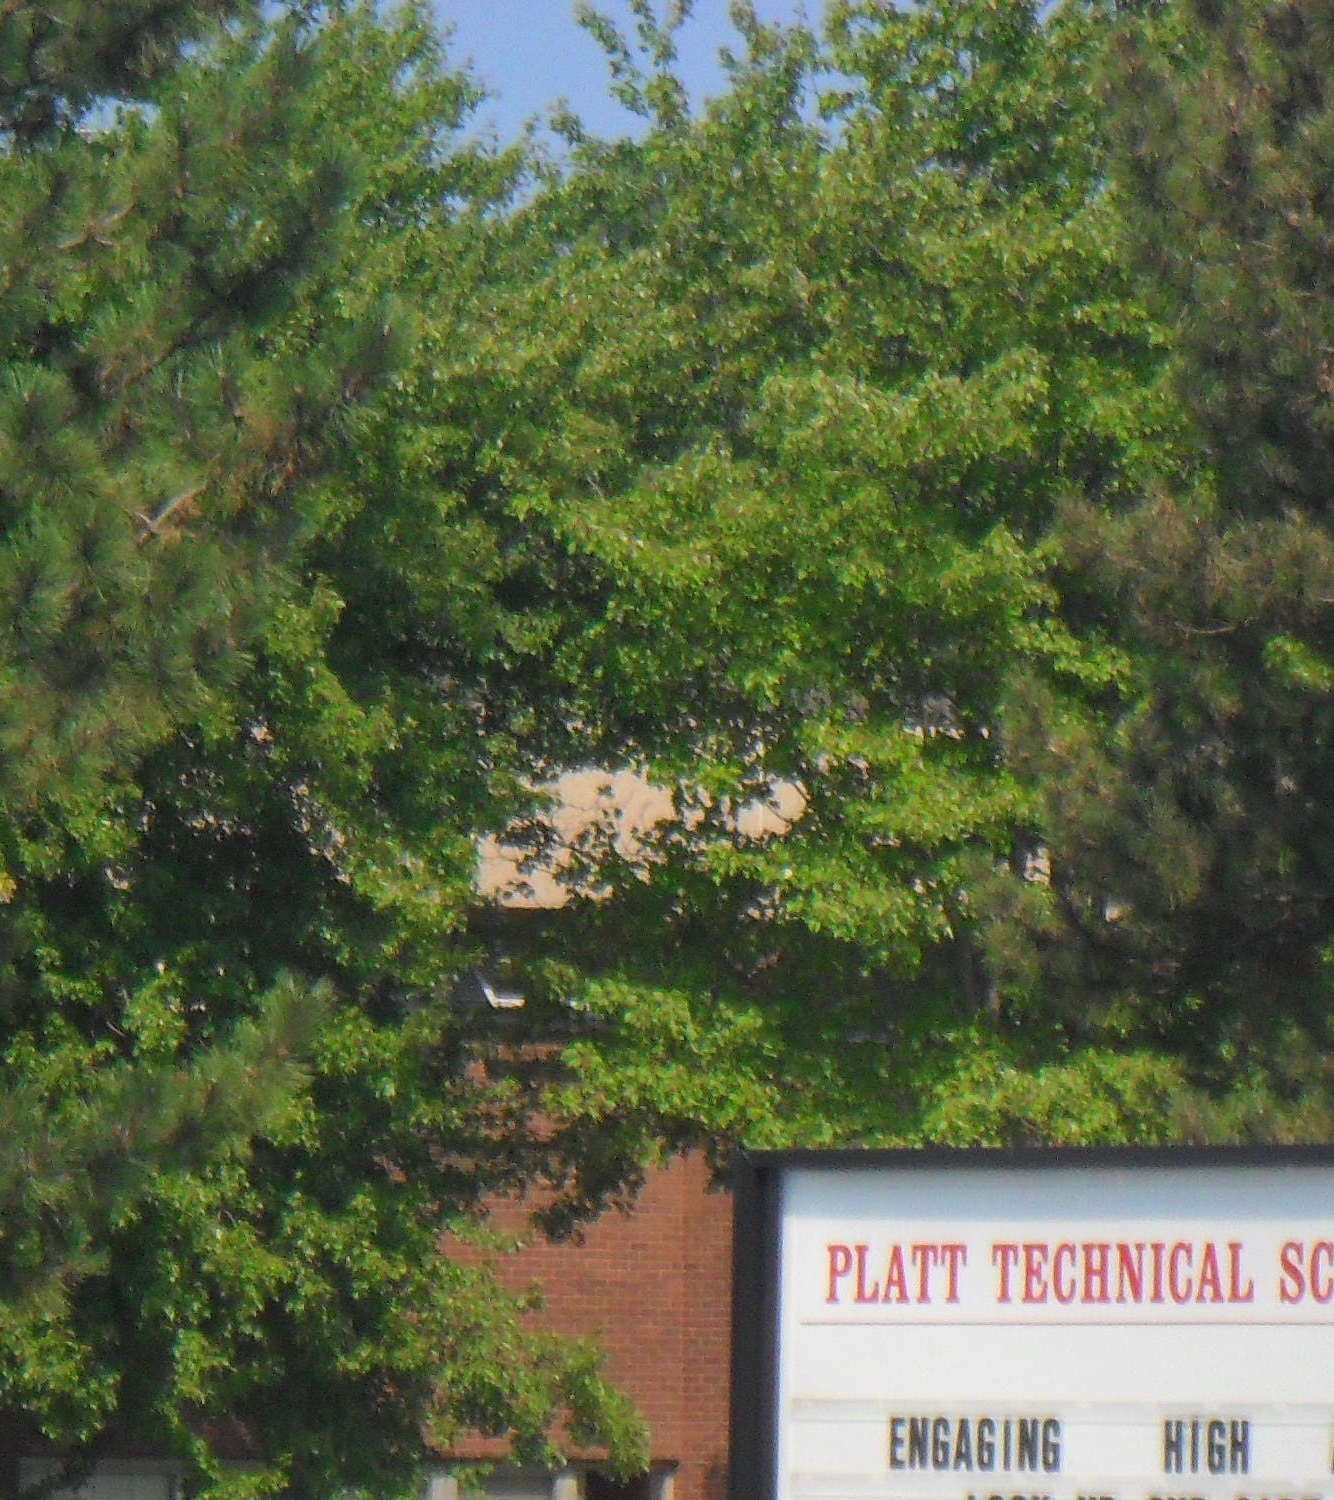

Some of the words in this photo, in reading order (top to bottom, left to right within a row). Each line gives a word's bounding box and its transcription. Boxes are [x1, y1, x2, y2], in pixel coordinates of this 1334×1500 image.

[825, 1241, 968, 1305] PLATT
[990, 1239, 1255, 1305] TECHNICAL
[889, 1416, 1060, 1471] ENGAGING
[1163, 1419, 1250, 1474] HIGH
